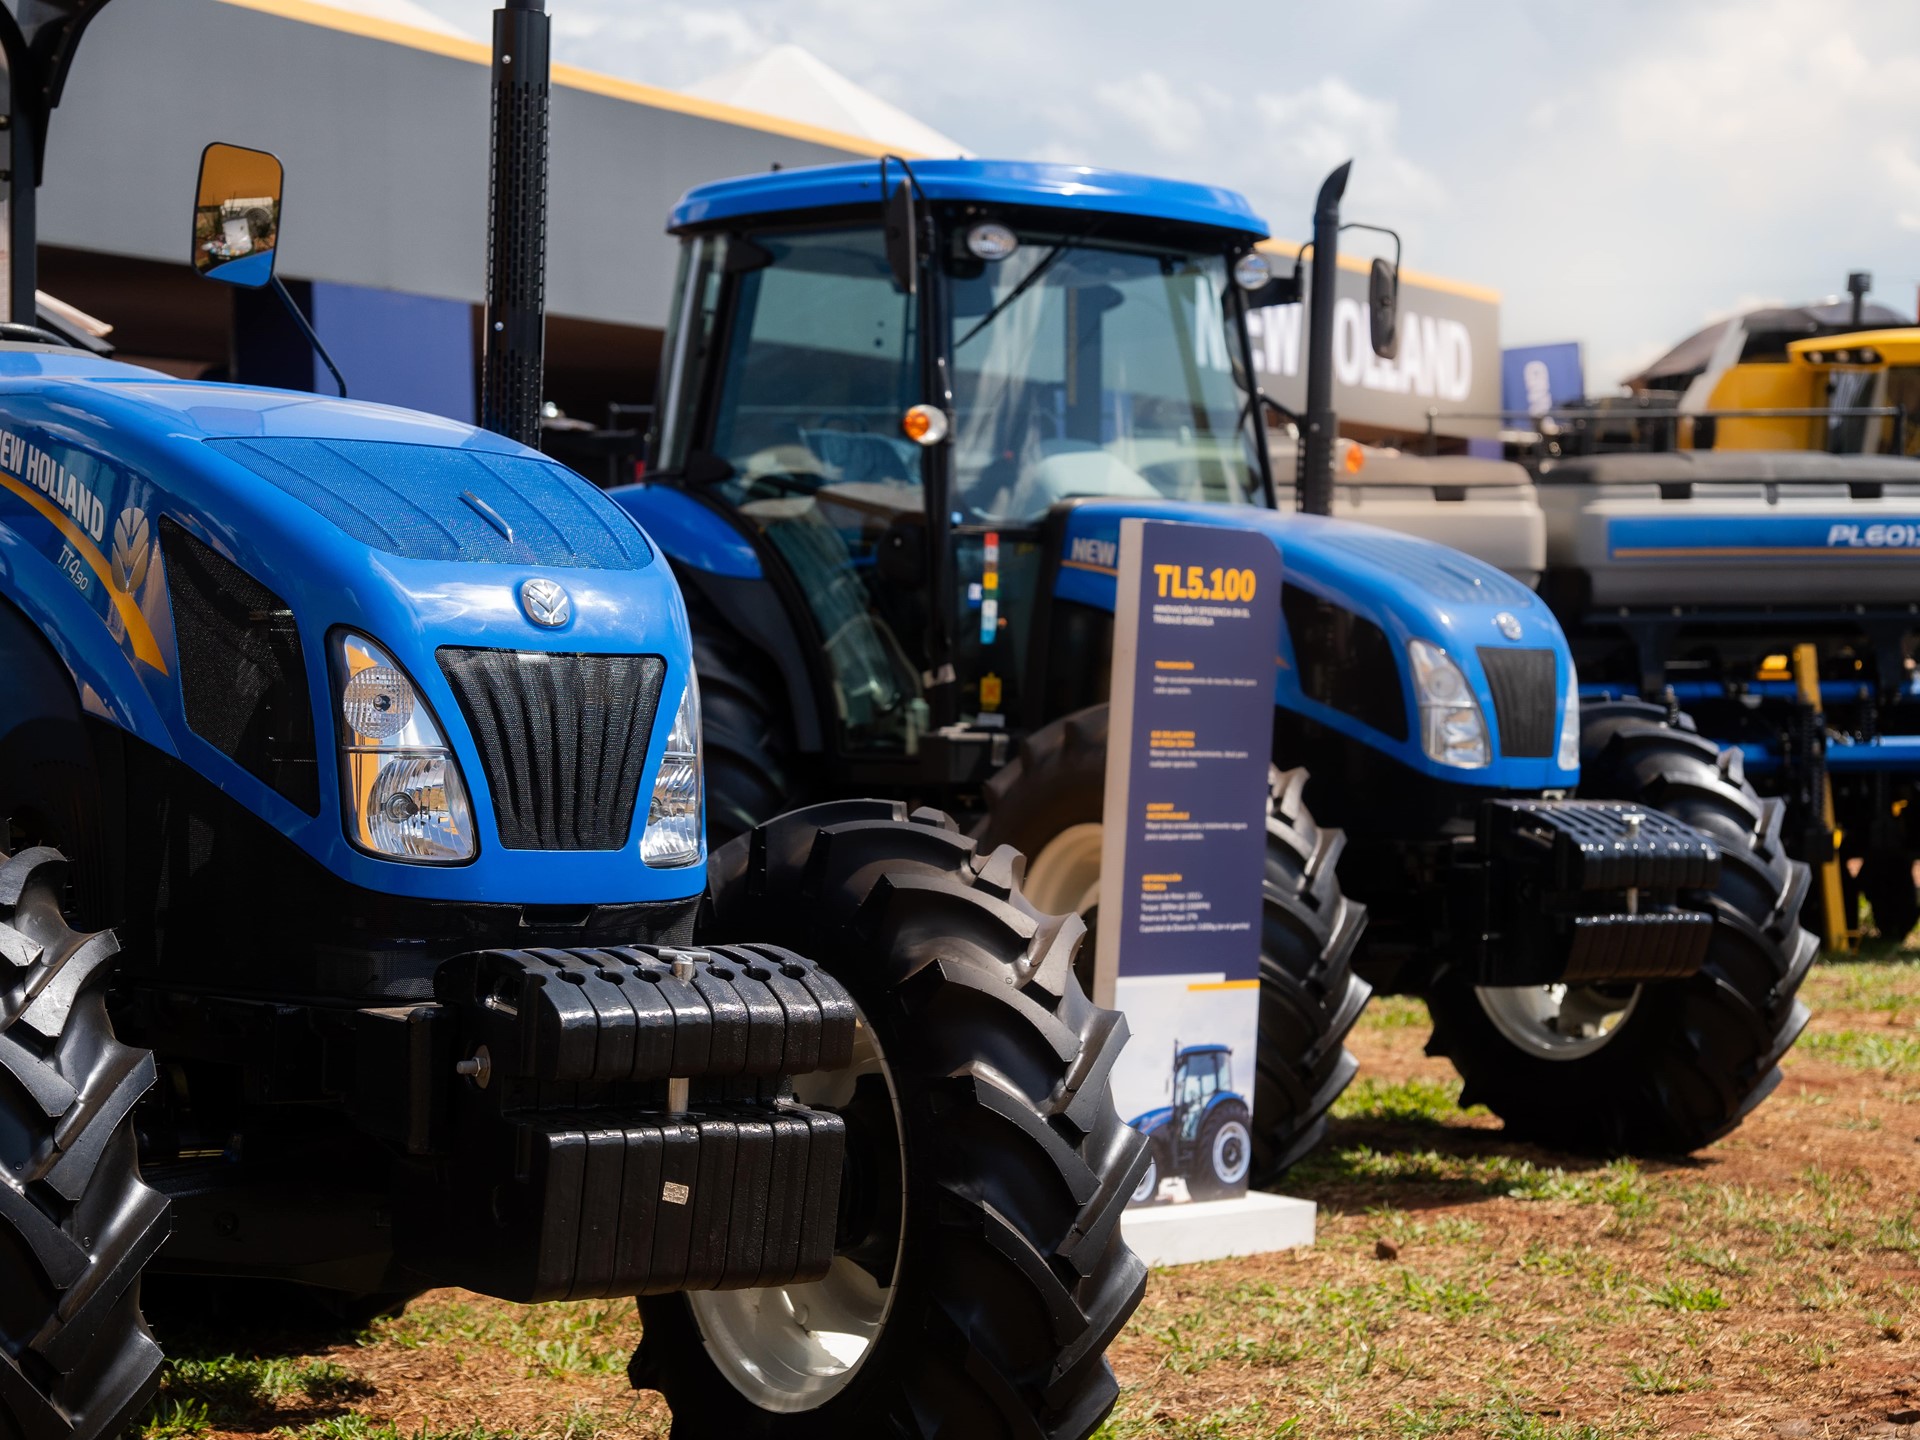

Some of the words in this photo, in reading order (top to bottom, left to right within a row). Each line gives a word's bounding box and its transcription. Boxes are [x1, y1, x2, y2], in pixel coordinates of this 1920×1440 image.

[1332, 297, 1473, 402] OLLAND
[0, 429, 26, 475] EW
[26, 443, 104, 543] HOLLAND
[1071, 537, 1117, 567] NEW
[1827, 523, 1920, 547] PL601
[1153, 564, 1257, 602] TL5.100
